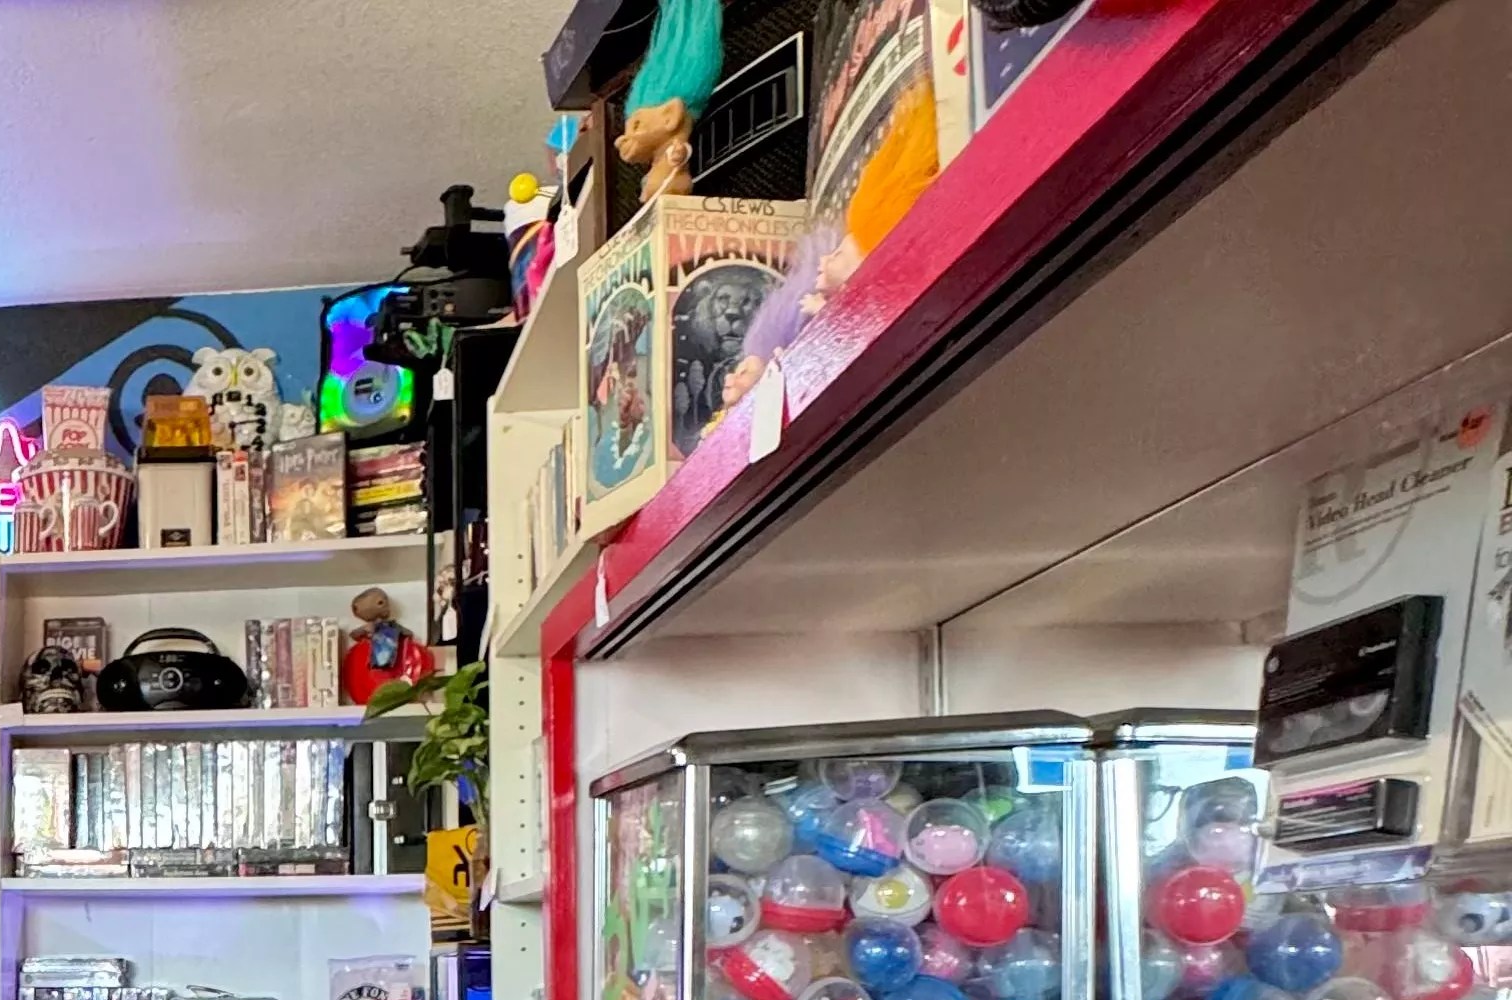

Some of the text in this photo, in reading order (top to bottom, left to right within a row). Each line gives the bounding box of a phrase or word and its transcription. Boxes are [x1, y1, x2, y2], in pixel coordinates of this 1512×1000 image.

[731, 200, 775, 216] LEWIS
[665, 213, 693, 231] THE
[694, 215, 789, 236] CHRONICLES
[1307, 506, 1349, 530] Video
[1353, 480, 1397, 513] Head
[1400, 456, 1474, 493] Cleaner
